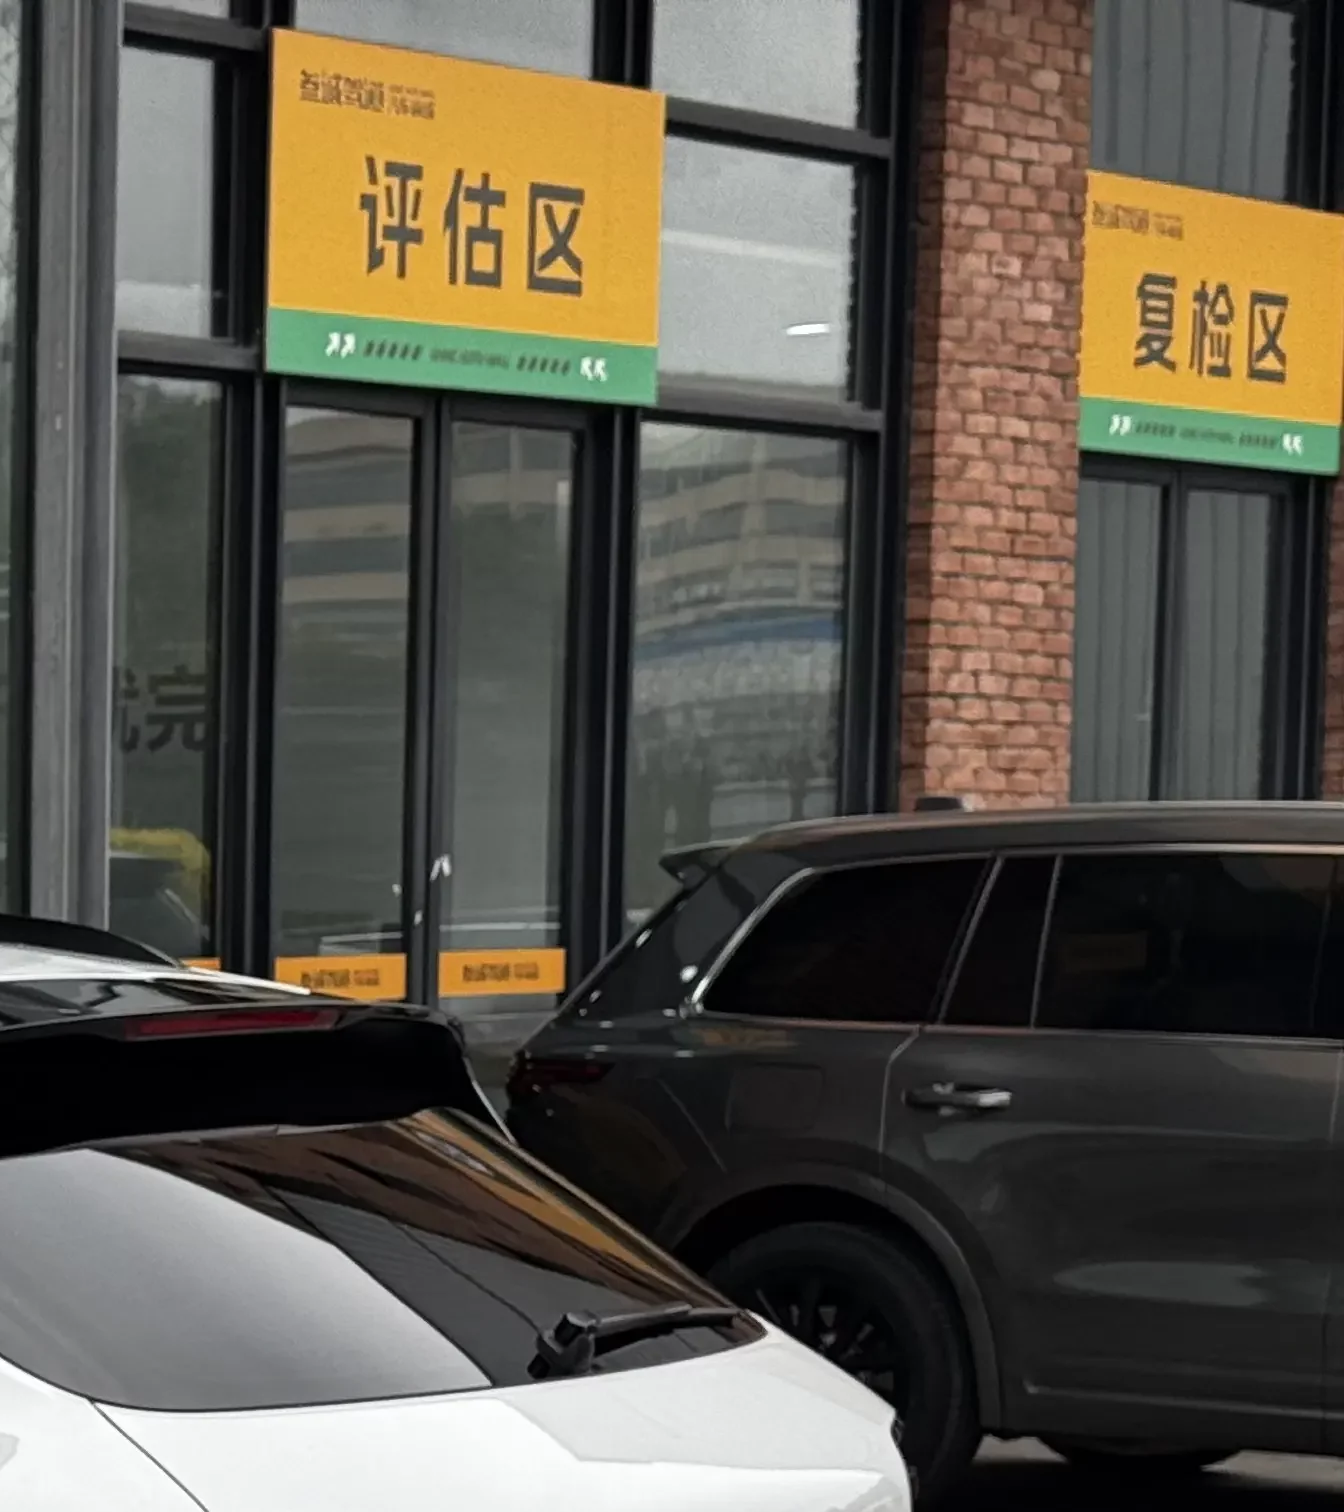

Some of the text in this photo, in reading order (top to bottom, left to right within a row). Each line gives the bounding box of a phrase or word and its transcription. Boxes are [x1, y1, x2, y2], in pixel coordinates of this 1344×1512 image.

[358, 154, 586, 298] 评估区
[1133, 273, 1289, 383] 复检区
[113, 664, 208, 754] 完
